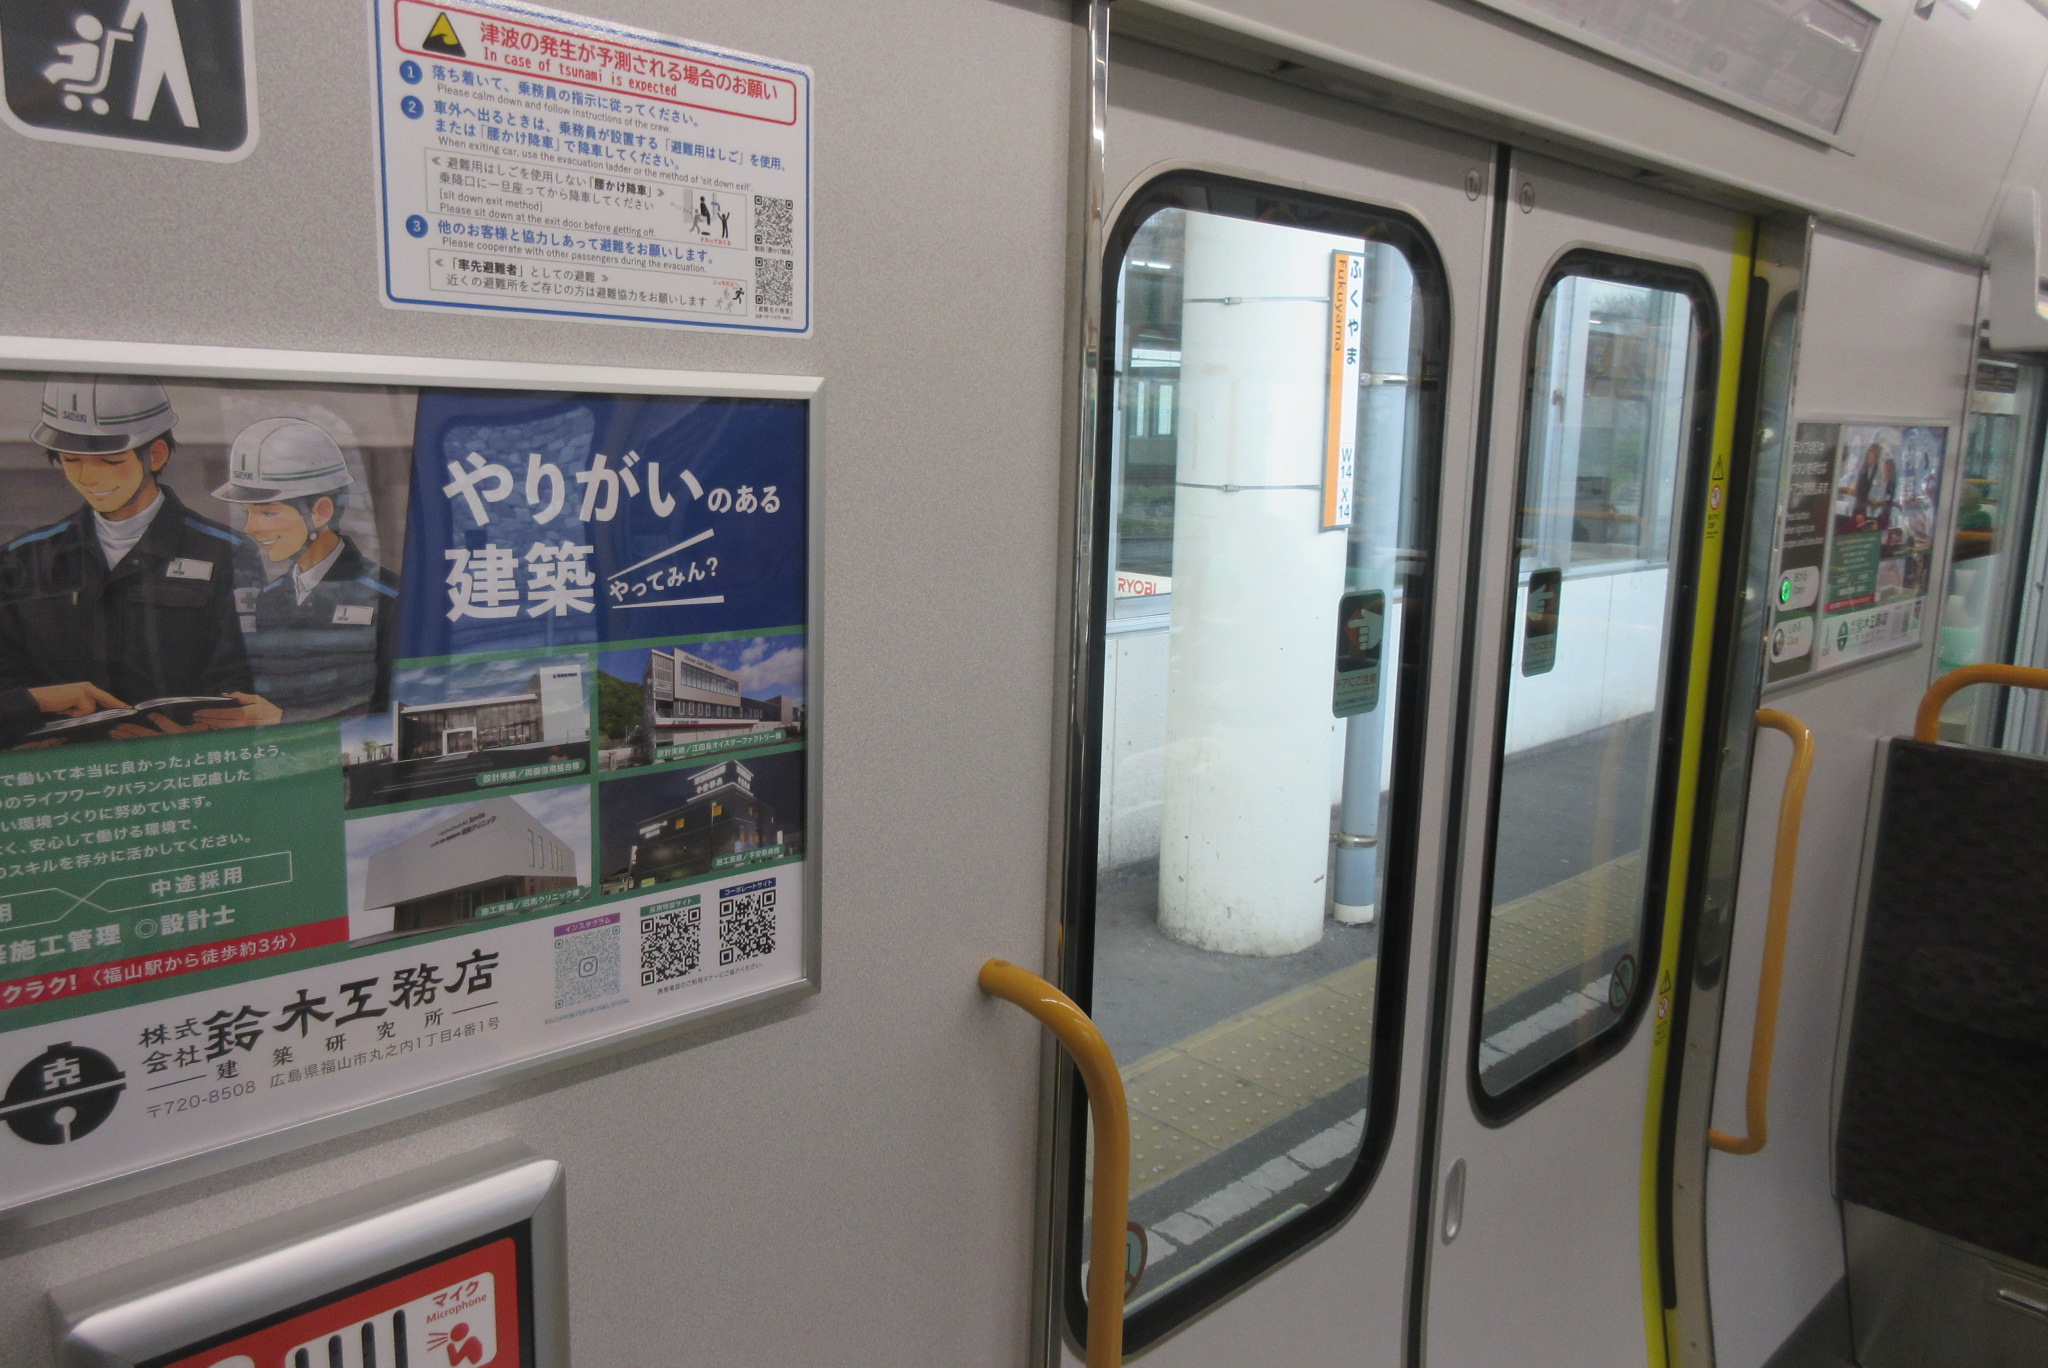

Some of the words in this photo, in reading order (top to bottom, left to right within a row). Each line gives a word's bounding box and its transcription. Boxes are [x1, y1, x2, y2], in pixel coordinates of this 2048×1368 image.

[481, 21, 778, 100] 津波の発生が予測される場合のお願い
[484, 47, 498, 62] In
[504, 55, 531, 69] case
[538, 60, 551, 73] of
[559, 62, 603, 83] tsunami
[611, 72, 623, 86] is
[628, 76, 677, 97] expected
[432, 64, 699, 128] 落ち着いて、乗務員の指示に従ってください。
[437, 83, 470, 98] Please
[472, 89, 495, 103] calm
[497, 93, 522, 107] down
[525, 99, 542, 111] and
[544, 102, 570, 116] follow
[572, 107, 623, 125] instructions
[625, 117, 633, 127] of
[635, 118, 648, 129] the
[650, 122, 671, 133] crew.
[435, 118, 680, 170] または「腰かけ降車」で降車してください。
[438, 135, 466, 150] When
[469, 140, 500, 155] exiting
[502, 147, 519, 159] car,
[522, 150, 538, 160] use
[540, 151, 555, 163] the
[557, 154, 604, 170] evacuation
[605, 161, 632, 175] ladder
[634, 166, 642, 175] or
[644, 168, 658, 178] the
[659, 169, 689, 184] method
[690, 174, 699, 184] of
[713, 178, 734, 189] down
[439, 189, 455, 202] [sit
[457, 191, 483, 203] down
[486, 194, 502, 206] exit
[505, 199, 543, 212] method]
[440, 172, 654, 210] 乗降口に一旦座ってから降車してください
[440, 202, 472, 217] Please
[474, 207, 486, 217] sit
[489, 208, 513, 221] down
[516, 213, 526, 222] at
[527, 213, 542, 224] the
[544, 216, 560, 227] exit
[563, 217, 582, 229] door
[584, 220, 612, 233] before
[613, 225, 642, 237] getting
[643, 228, 656, 238] off.
[438, 219, 713, 265] 他のお客様と協力しあって避難をお願いします。
[442, 237, 474, 250] Please
[476, 240, 523, 255] cooperate
[525, 245, 544, 256] with
[547, 247, 569, 259] other
[571, 251, 619, 265] passengers
[620, 254, 647, 268] during
[648, 257, 661, 268] the
[663, 259, 707, 273] evacuation.
[447, 273, 707, 308] 近くの避難所をご存じの方は避難協力をお願いします
[1334, 260, 1347, 351] Fukuyama
[1346, 260, 1362, 365] ふくやま
[1340, 464, 1352, 479] 14
[1341, 448, 1353, 463] W
[1338, 504, 1350, 519] 14
[1341, 488, 1349, 502] X
[444, 540, 596, 622] 建築
[609, 557, 719, 603] やってみん?
[1118, 577, 1157, 597] RYOBI
[0, 769, 251, 809] のライフワークバランスに配慮した
[0, 819, 199, 855] く、安心して働ける環境で、
[151, 866, 243, 898] 中途採用
[724, 878, 773, 897] コーポレートサイト
[564, 916, 612, 933] インスタグラム
[0, 924, 121, 964] 施工管理
[203, 949, 499, 1062] 鈴木工務店
[138, 1017, 202, 1048] 株式
[142, 1044, 202, 1074] 会社
[147, 1080, 256, 1118] 〒720-8508
[270, 1016, 500, 1088] 広島県福山市丸之内1丁目4番1号
[426, 1293, 487, 1324] Microphone
[432, 1280, 480, 1307] マイク
